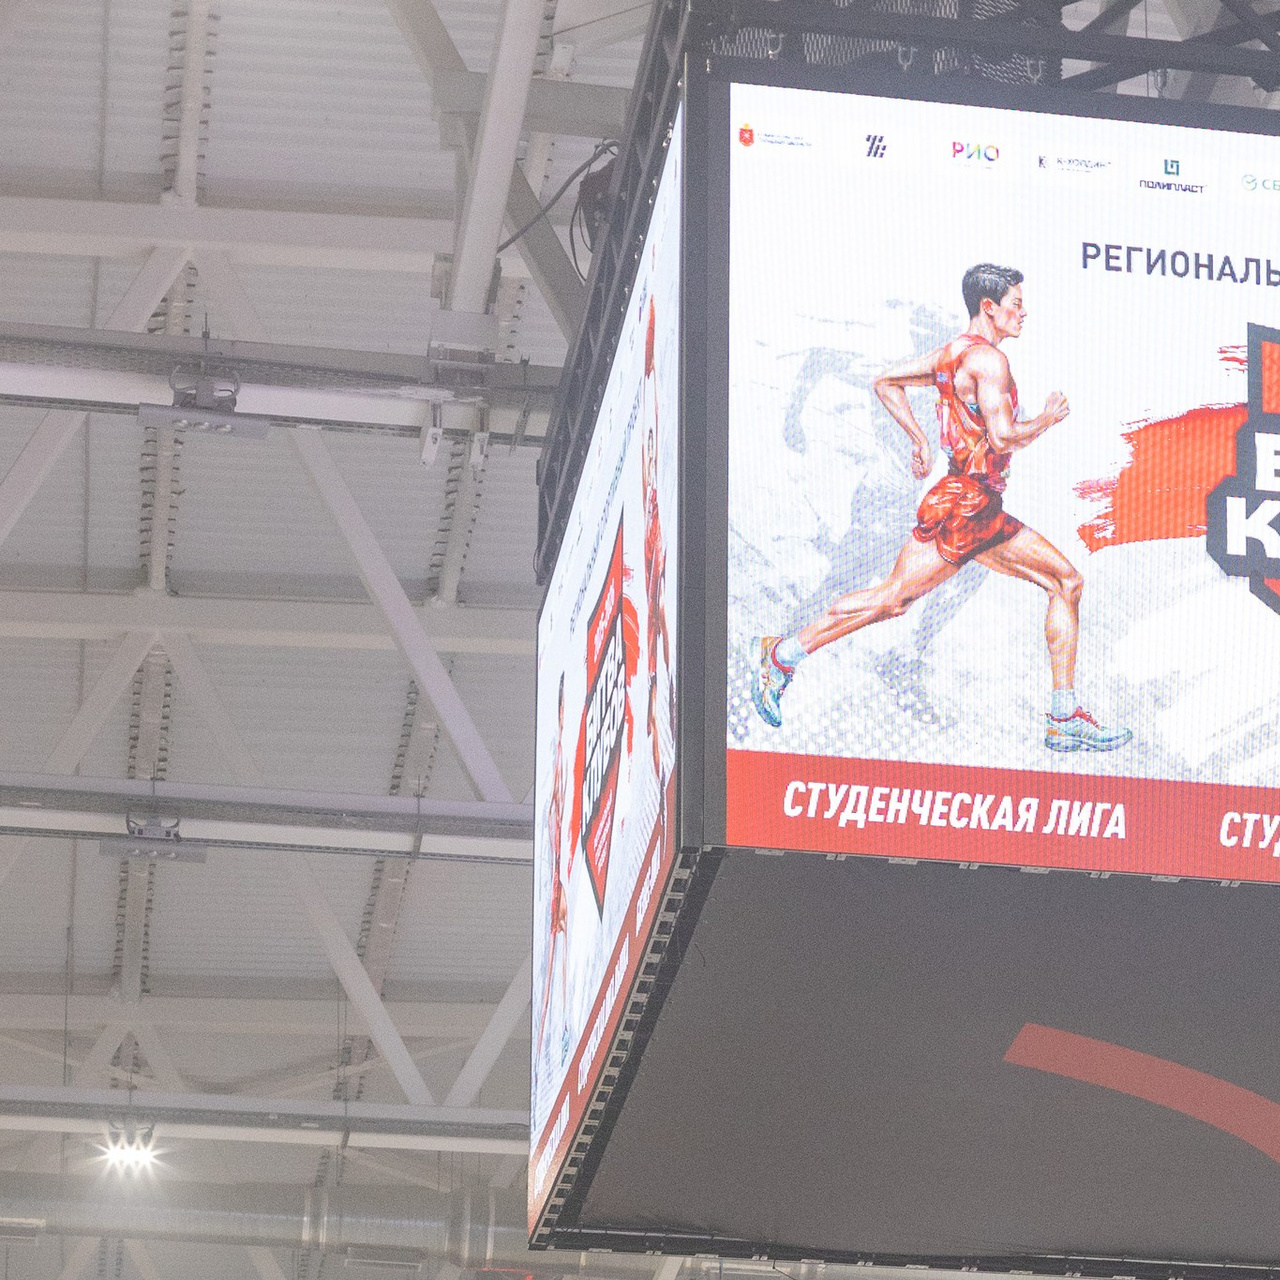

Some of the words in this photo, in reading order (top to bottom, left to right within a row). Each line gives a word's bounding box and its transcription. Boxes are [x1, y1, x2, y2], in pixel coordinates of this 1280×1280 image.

[951, 141, 999, 162] РИО
[1139, 179, 1205, 194] ПОЛИПЛАСТ
[782, 780, 1037, 835] СТУДЕНЧЕСКАЯ
[1041, 798, 1127, 840] ЛИГА
